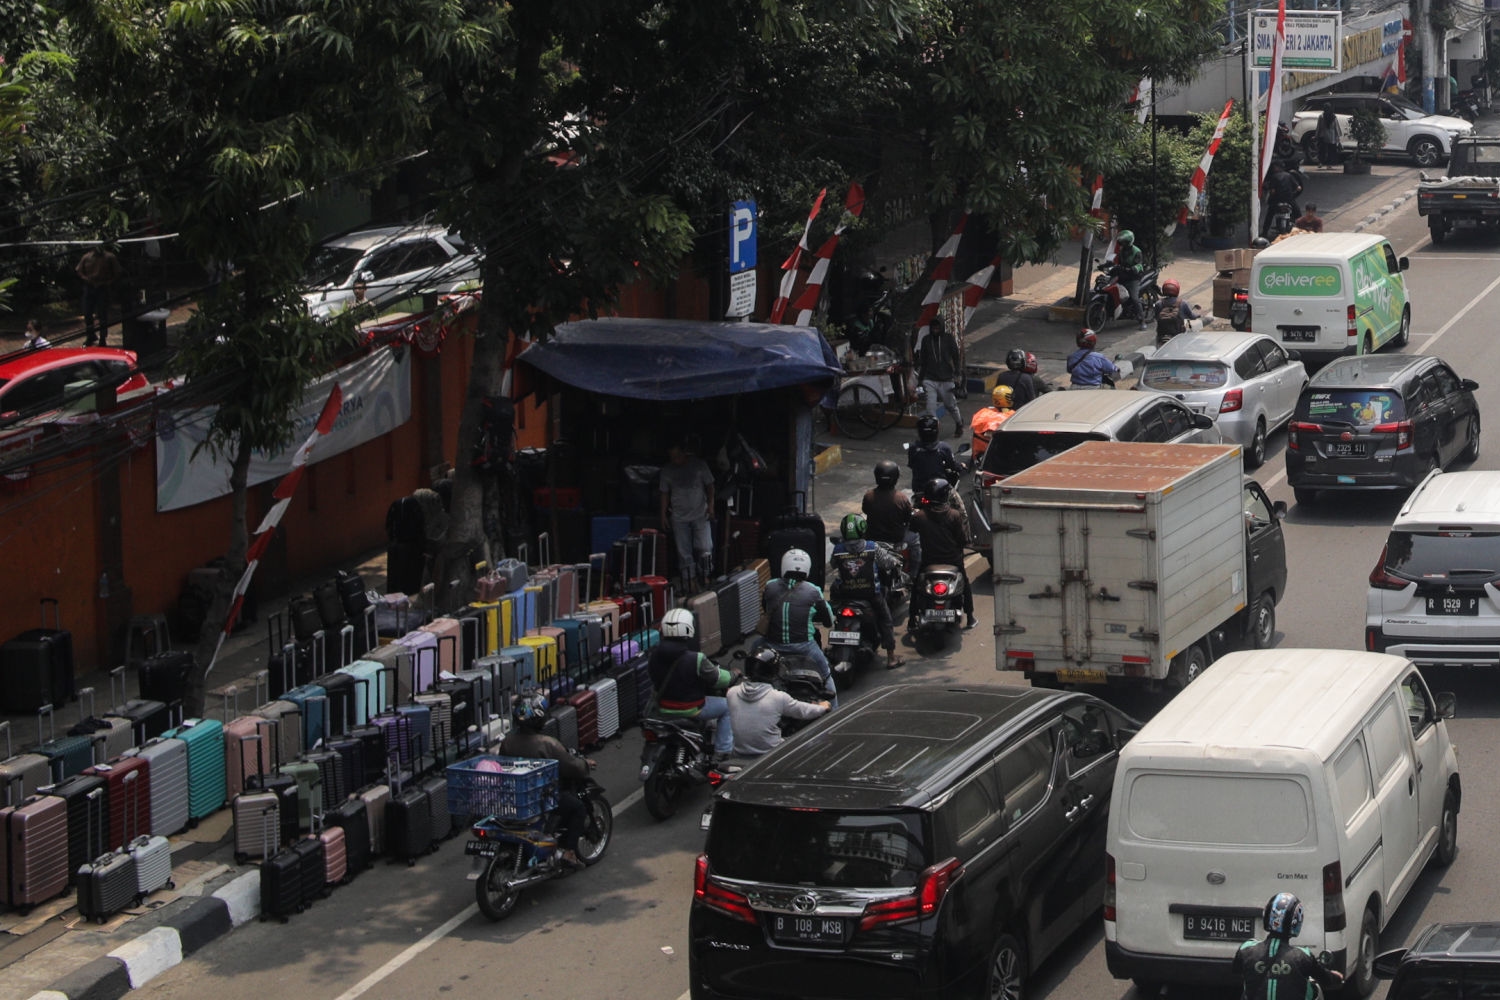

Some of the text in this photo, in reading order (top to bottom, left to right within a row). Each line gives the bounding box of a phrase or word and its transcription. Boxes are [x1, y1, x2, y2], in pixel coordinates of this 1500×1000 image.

[1257, 33, 1271, 50] SMA
[1297, 34, 1302, 50] 2
[1303, 34, 1333, 51] JAKARTA
[1265, 272, 1336, 288] deliveree
[1443, 599, 1461, 609] 1529
[777, 917, 842, 934] B 108 MSB
[1188, 918, 1250, 932] B 9416 NCE
[1254, 960, 1292, 975] Gab
